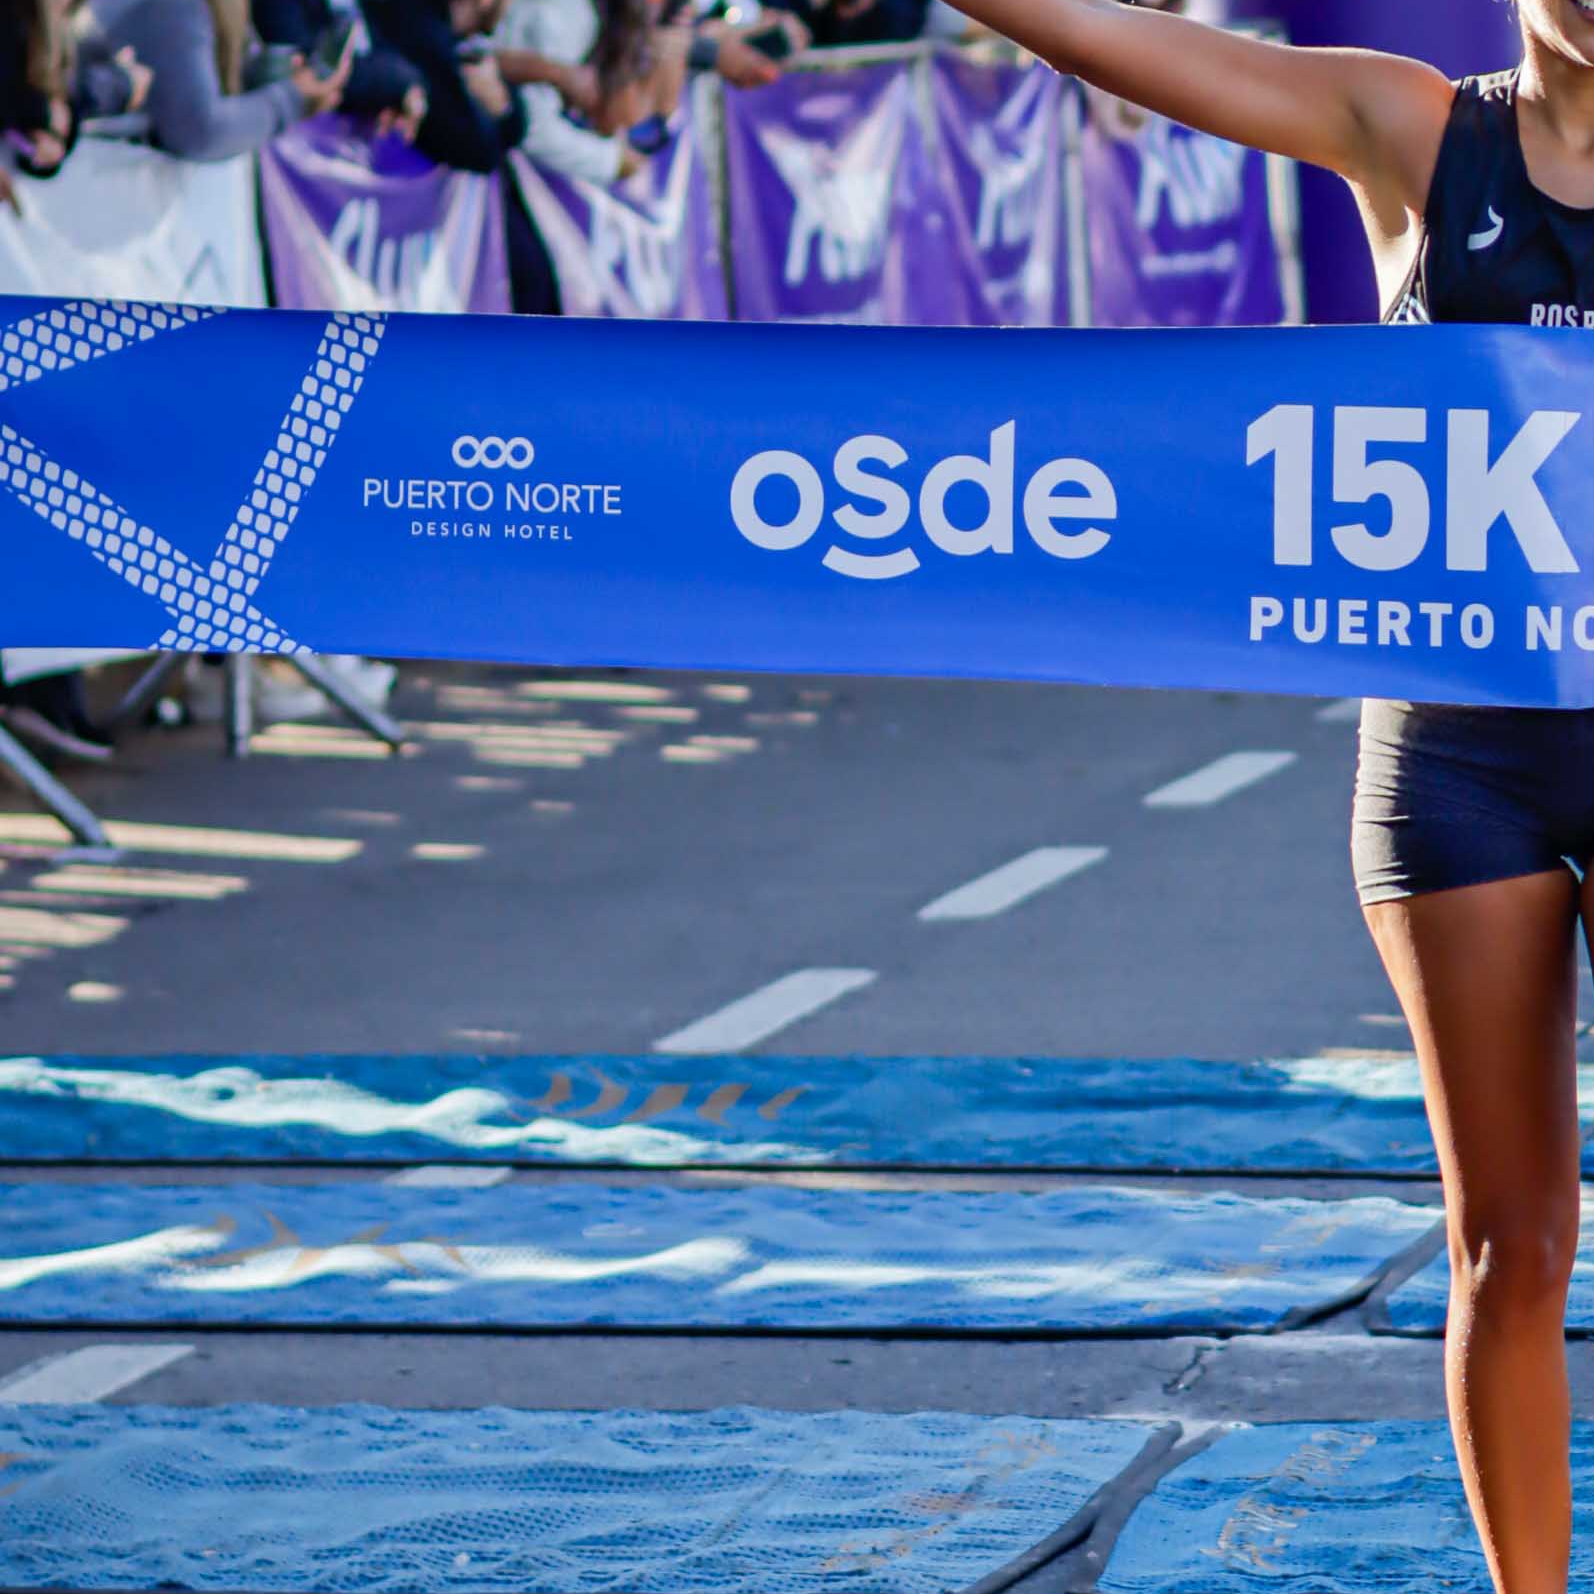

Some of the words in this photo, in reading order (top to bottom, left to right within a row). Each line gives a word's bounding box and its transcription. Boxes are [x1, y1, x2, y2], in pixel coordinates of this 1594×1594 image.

[363, 478, 494, 511] PUERTO
[506, 482, 622, 515] NORTE
[731, 420, 1117, 563] osde
[1246, 403, 1581, 573] 15K
[411, 520, 491, 538] DESIGN
[504, 524, 573, 541] HOTEL
[1249, 596, 1494, 649] PUERTO
